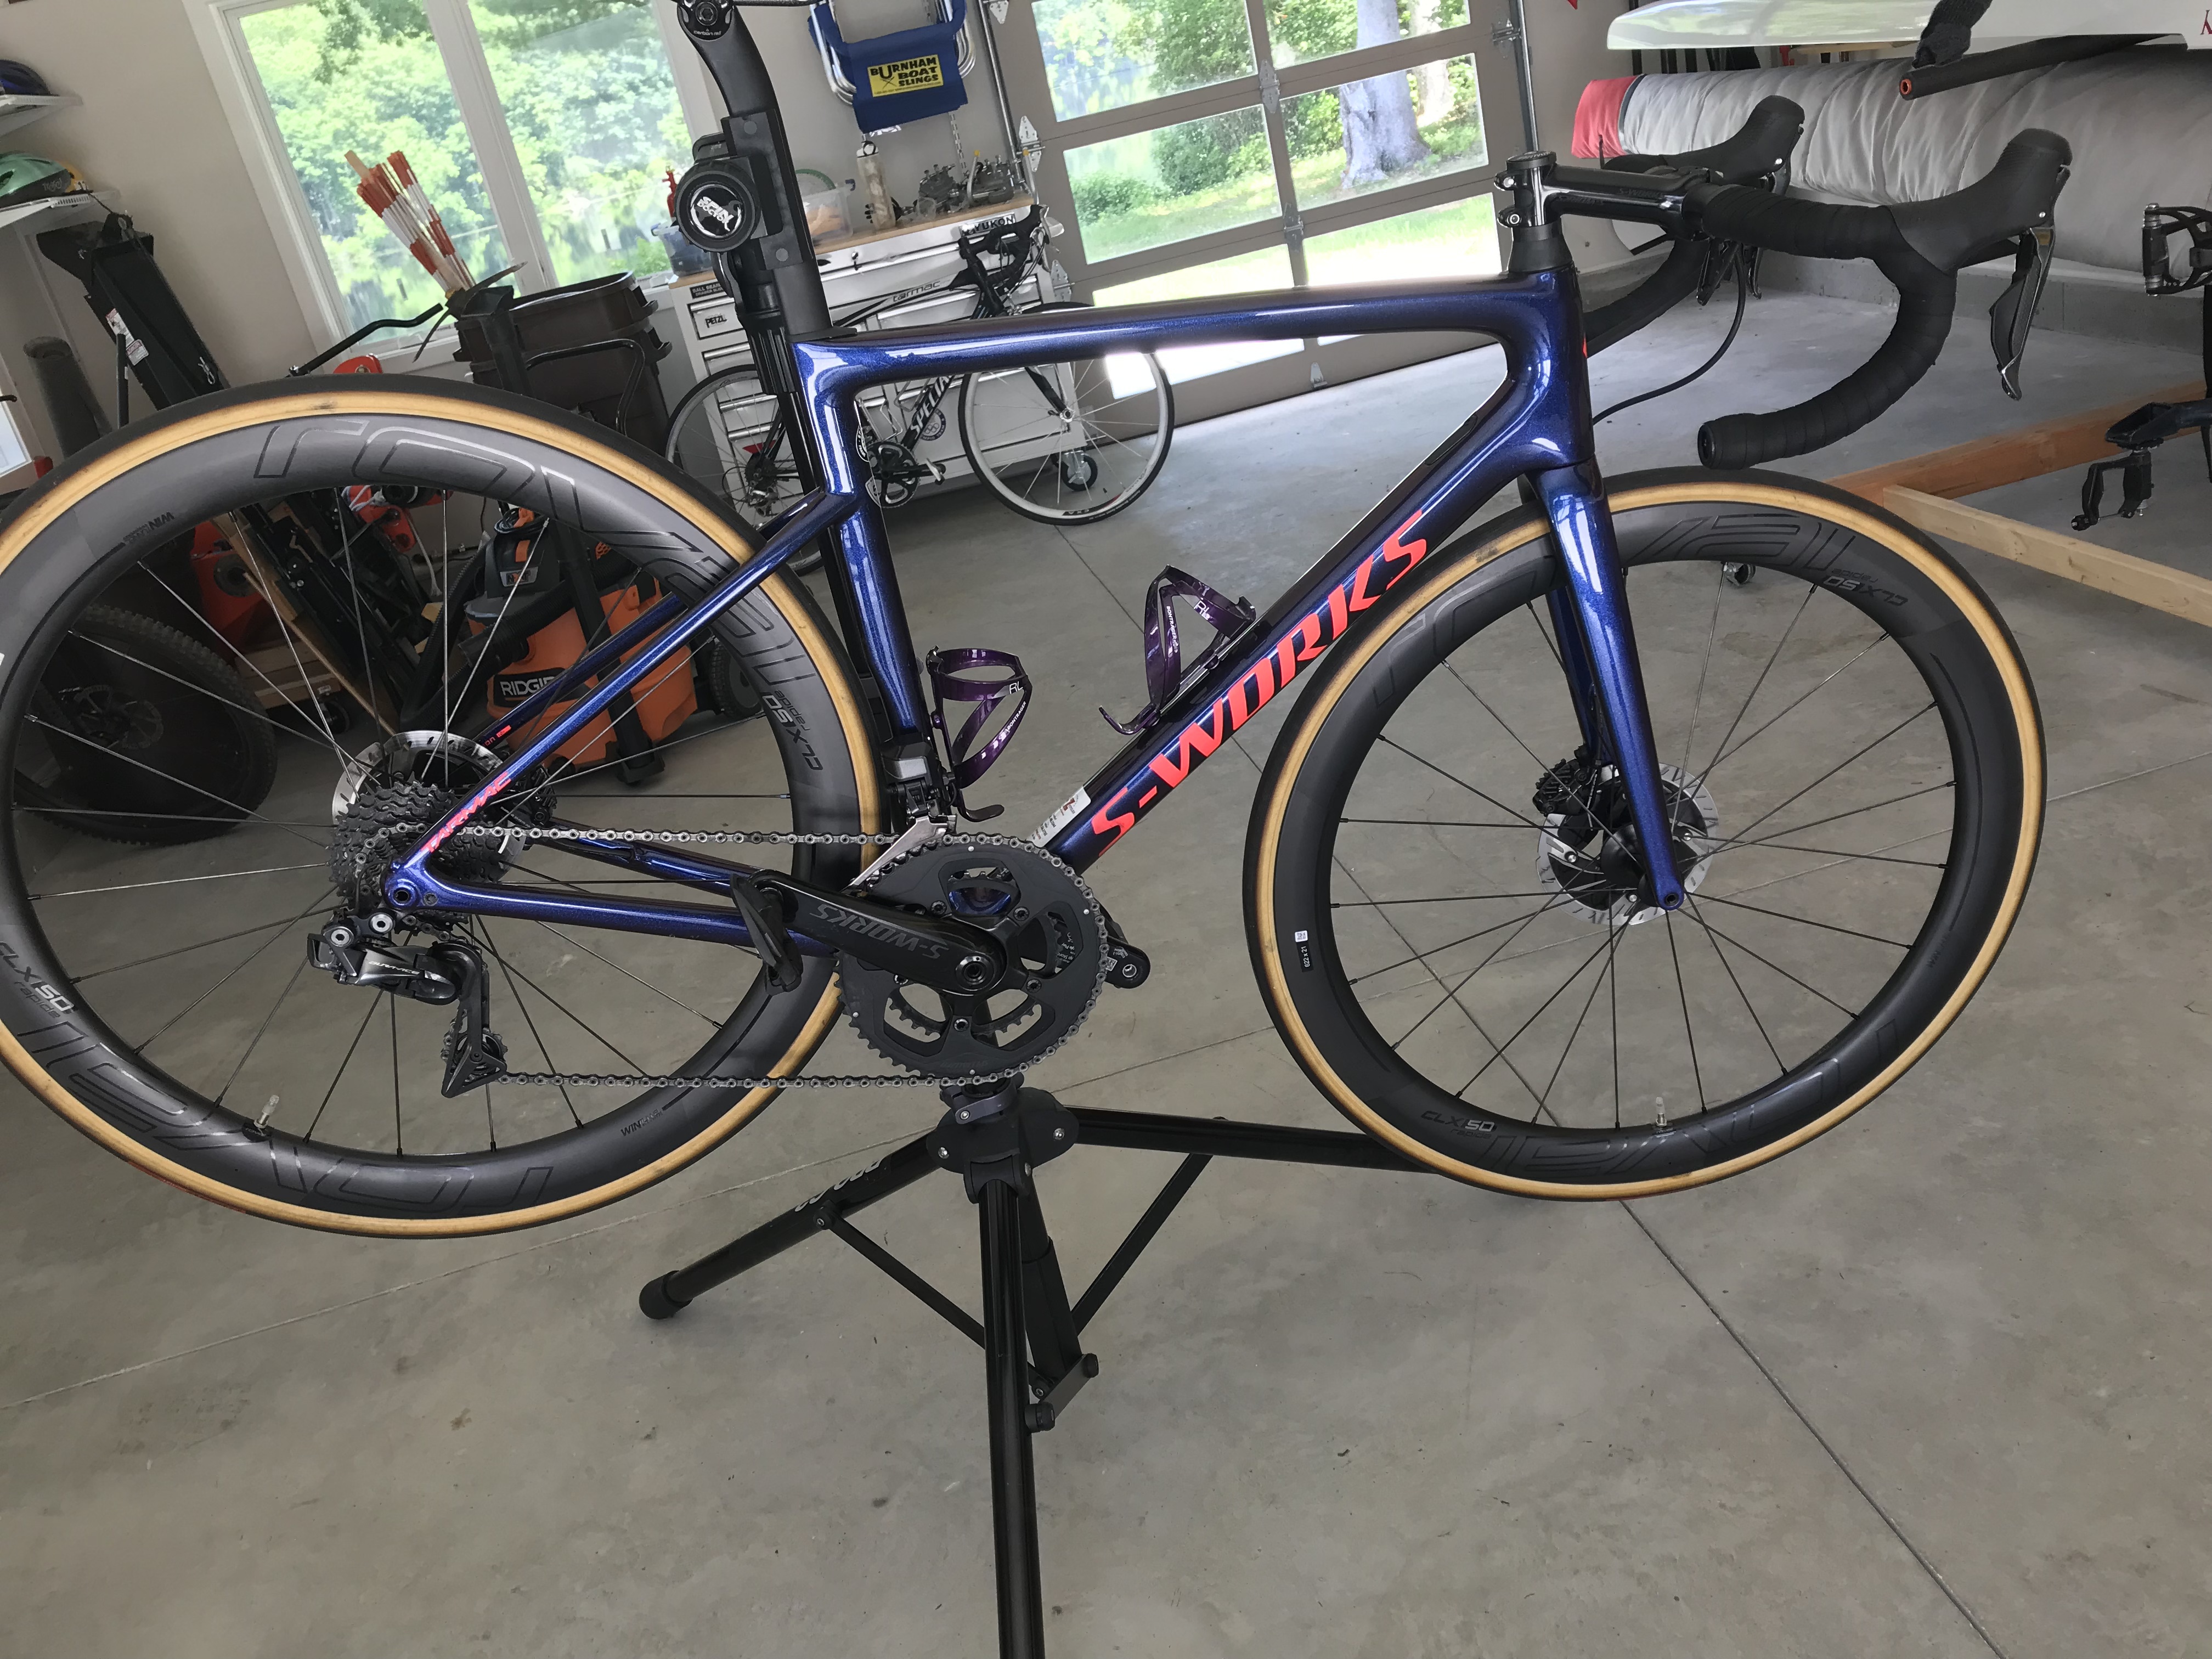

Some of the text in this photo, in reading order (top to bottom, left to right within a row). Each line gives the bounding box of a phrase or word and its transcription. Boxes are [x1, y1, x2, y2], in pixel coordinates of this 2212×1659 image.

[870, 57, 937, 79] BURNHAM
[898, 66, 938, 79] BOAT
[899, 74, 939, 87] SLINGS
[696, 199, 730, 232] DOCTOR
[703, 196, 734, 223] SPIN
[975, 216, 1013, 231] YUKON
[893, 281, 941, 302] tarmac
[705, 315, 727, 328] PETZL
[1166, 606, 1177, 640] BONTRAGER
[1009, 681, 1024, 695] RL
[1091, 509, 1426, 857] S-WORKS
[1007, 701, 1026, 730] BONTRAGER
[421, 771, 512, 853] TARMAC
[809, 904, 950, 959] S-WORKS
